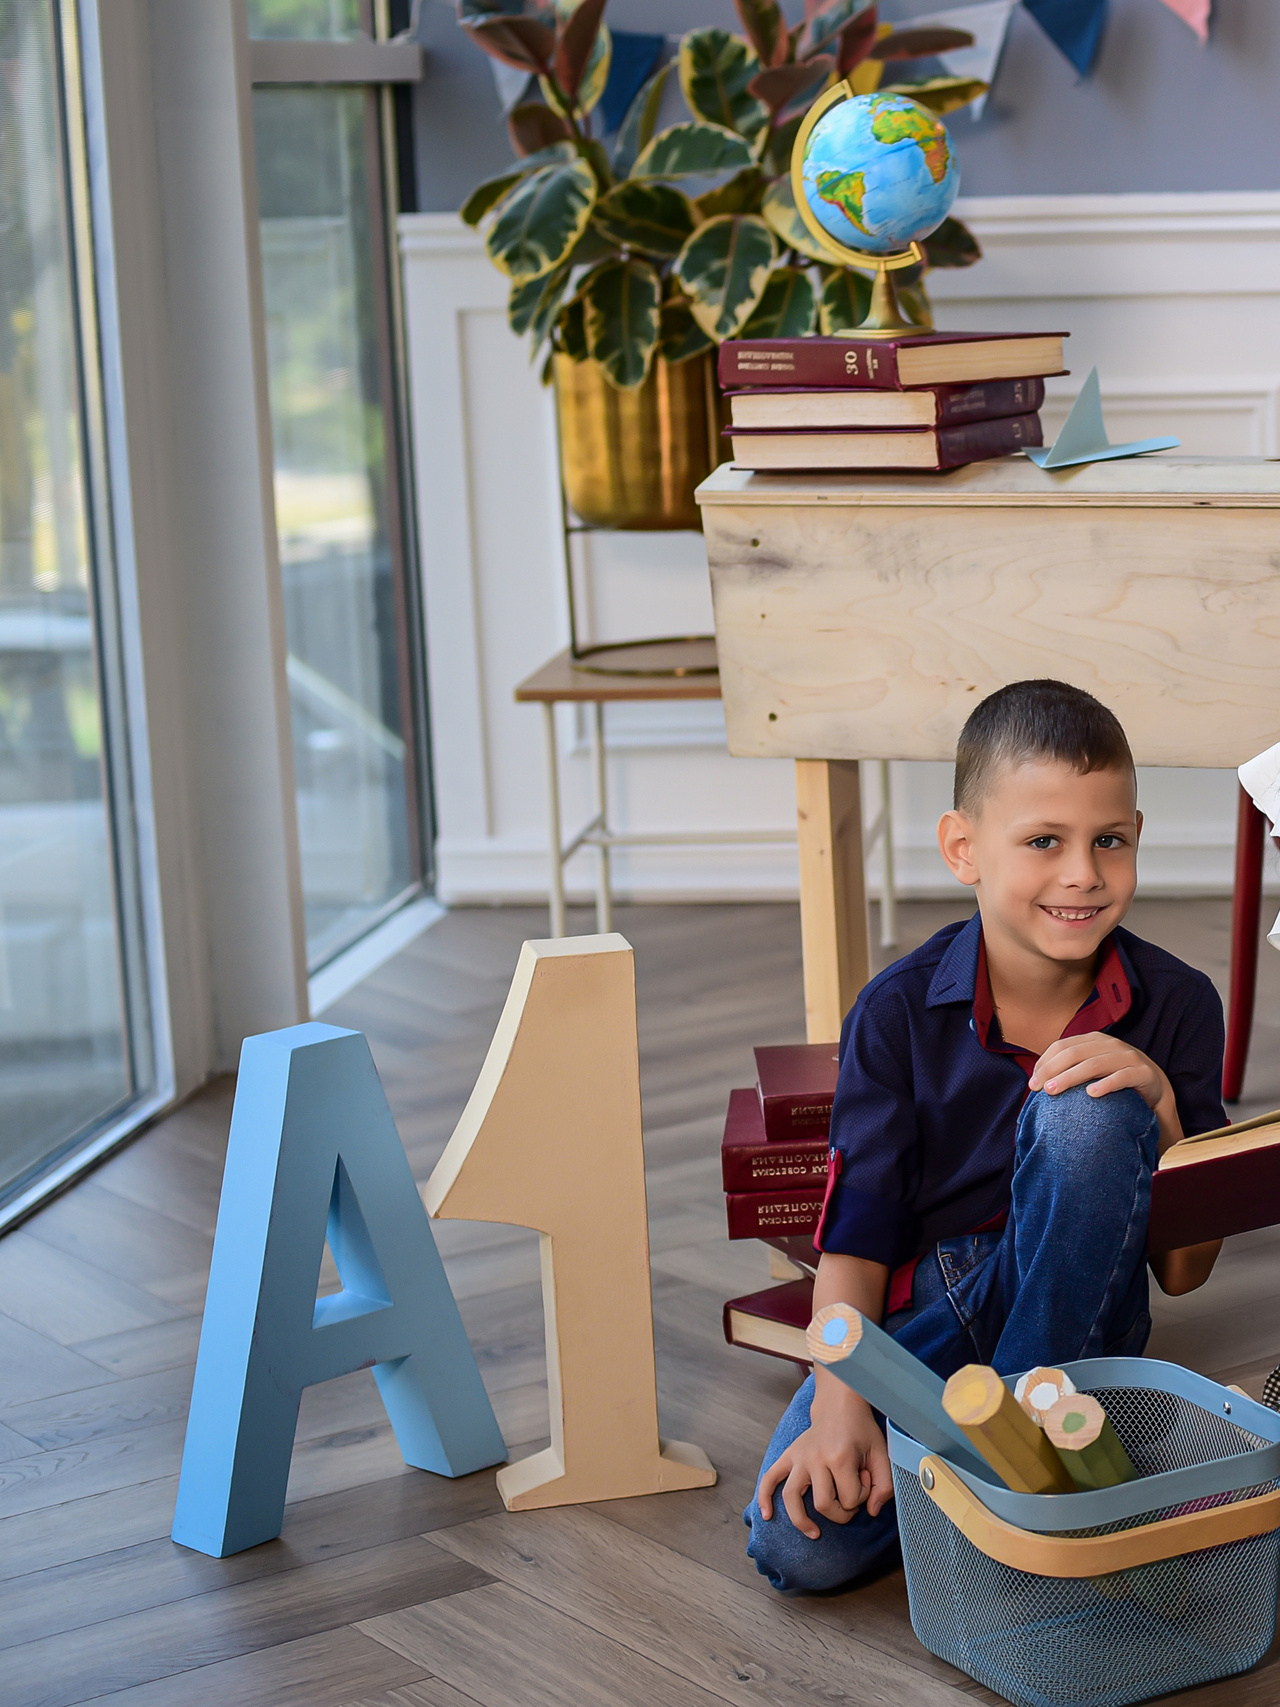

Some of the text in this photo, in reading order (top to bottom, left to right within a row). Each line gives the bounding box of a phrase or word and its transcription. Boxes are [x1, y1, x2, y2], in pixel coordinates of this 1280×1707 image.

[844, 351, 859, 375] 30
[752, 1153, 828, 1166] ИКЛОПЕДИЯ
[752, 1166, 807, 1177] СОВЕТСКАЯ
[757, 1202, 824, 1214] КЛОПЕДИЯ
[758, 1215, 812, 1225] СОВЕТСКАЯ
